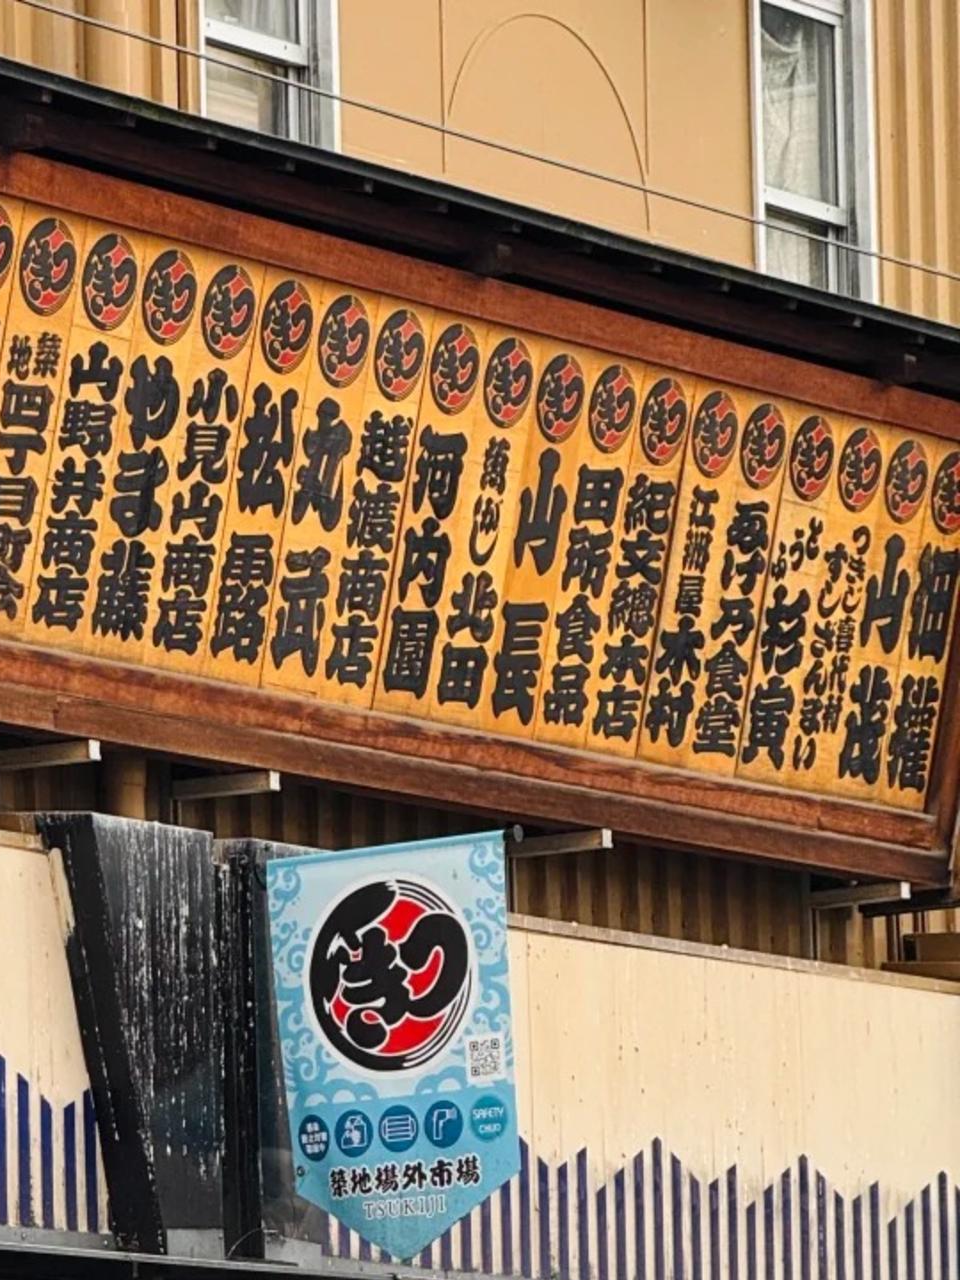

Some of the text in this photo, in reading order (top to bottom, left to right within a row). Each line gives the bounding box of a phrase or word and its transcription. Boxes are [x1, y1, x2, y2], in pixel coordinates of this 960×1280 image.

[329, 1155, 481, 1198] 築地場外市場
[363, 1196, 447, 1219] TSUKIJI
